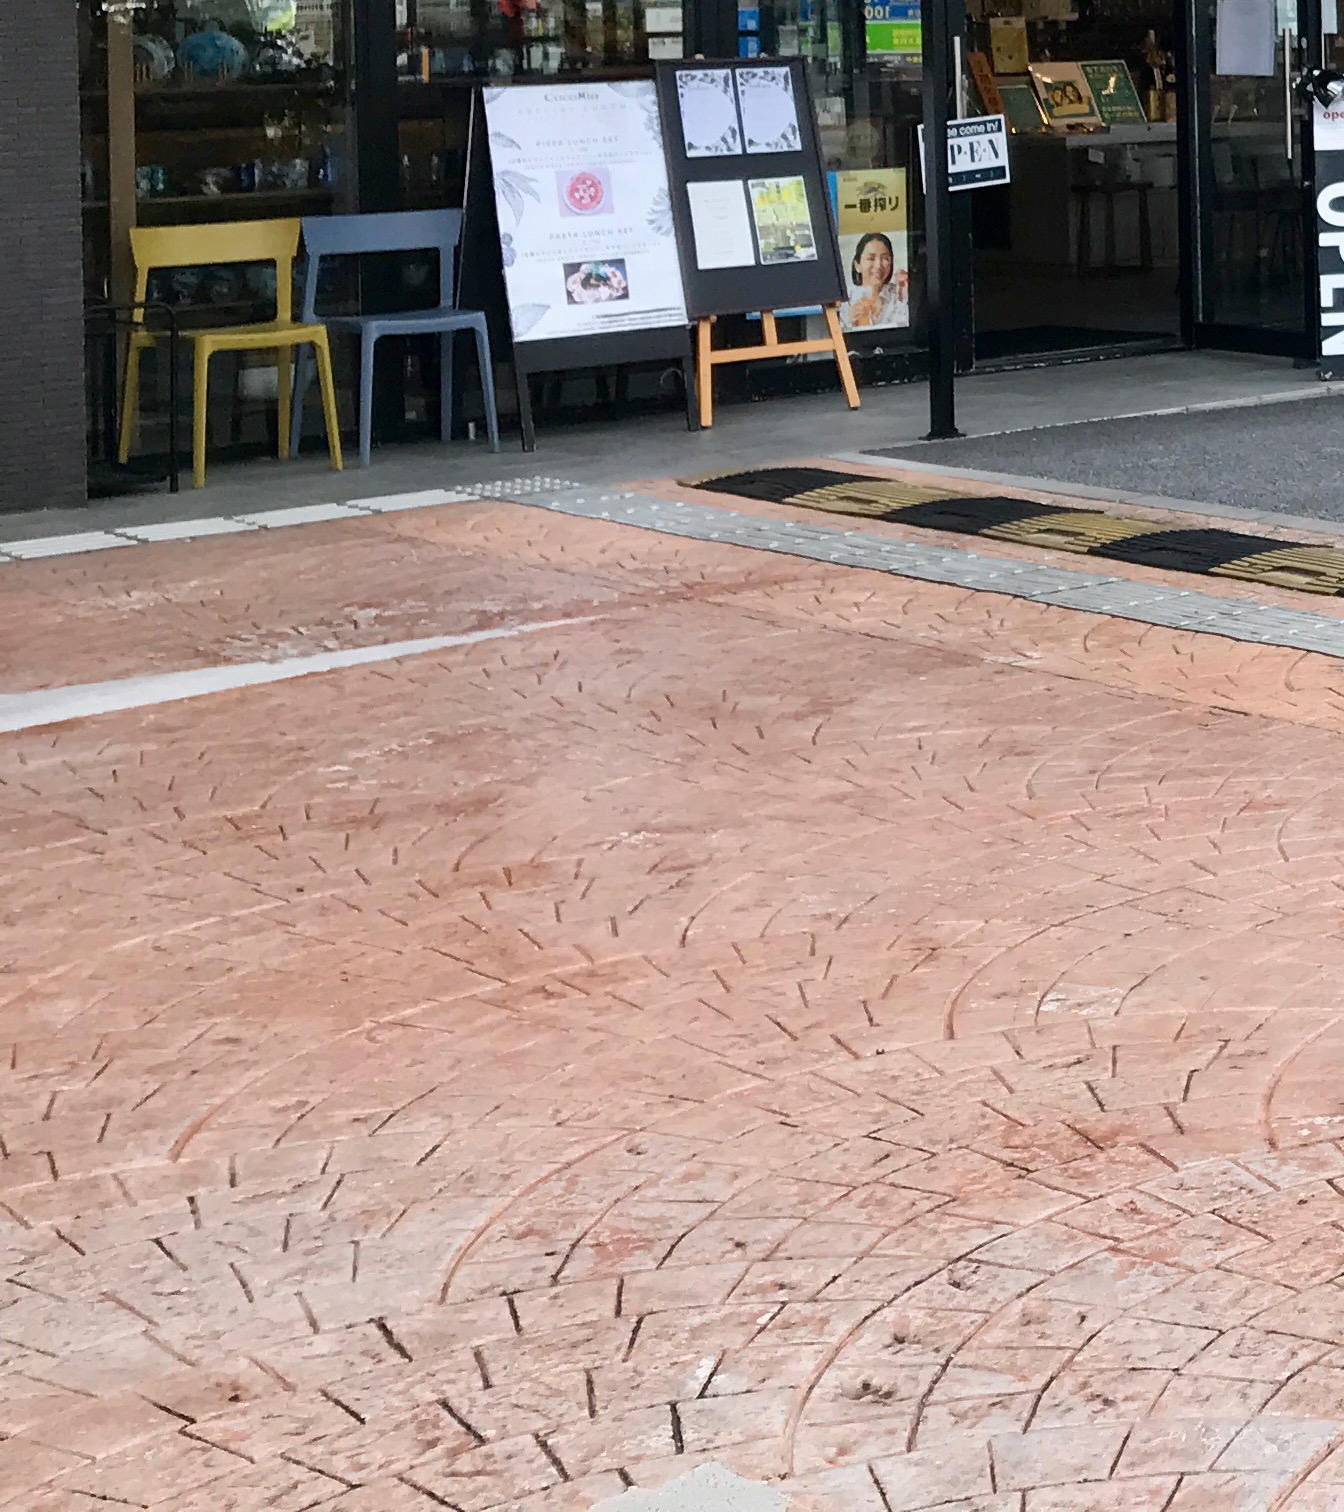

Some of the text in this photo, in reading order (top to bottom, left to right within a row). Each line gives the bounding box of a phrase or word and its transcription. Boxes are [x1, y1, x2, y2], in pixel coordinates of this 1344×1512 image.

[959, 124, 985, 136] come
[844, 196, 899, 214] 一番搾り
